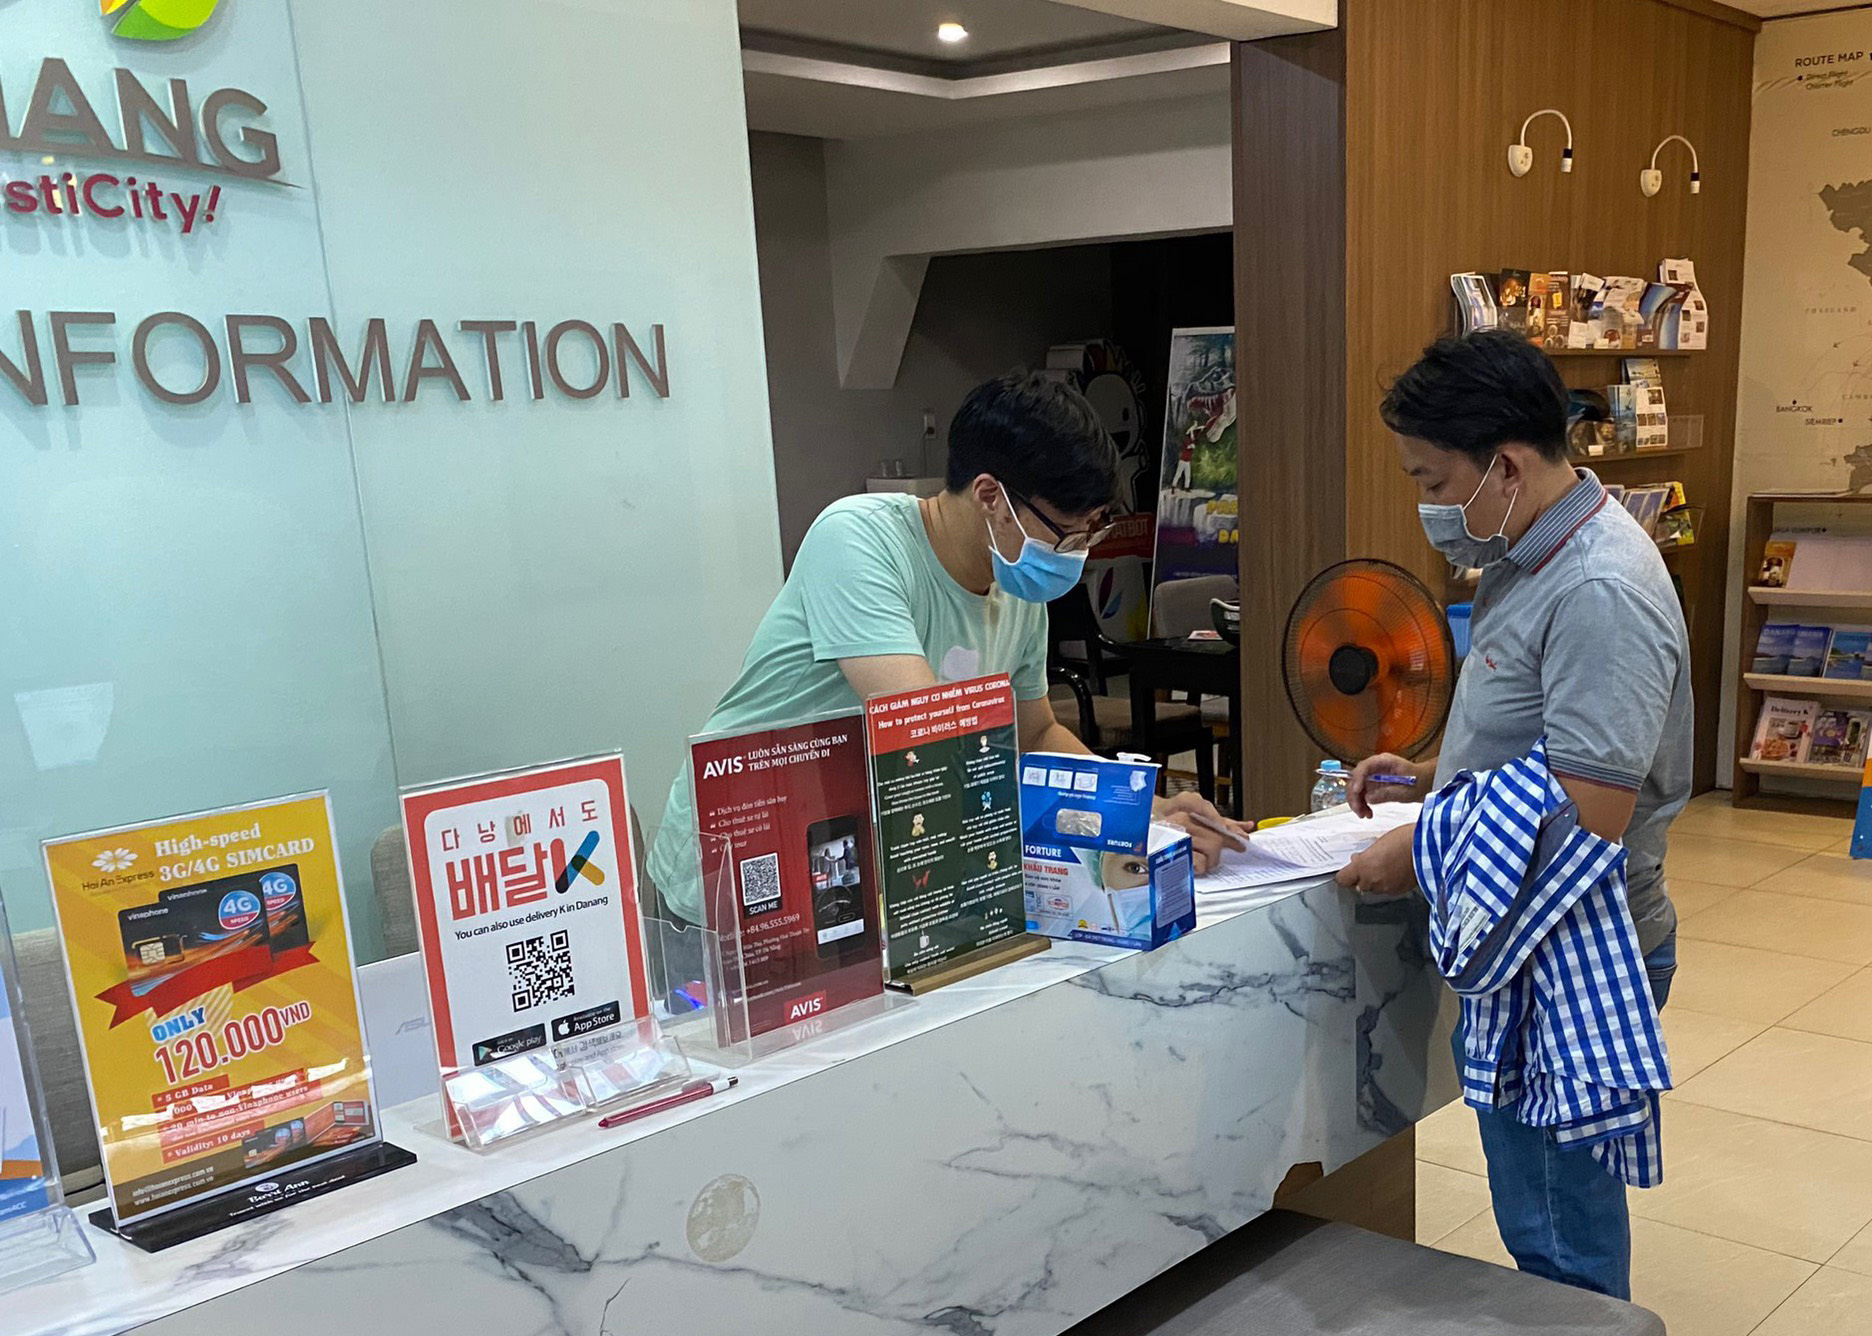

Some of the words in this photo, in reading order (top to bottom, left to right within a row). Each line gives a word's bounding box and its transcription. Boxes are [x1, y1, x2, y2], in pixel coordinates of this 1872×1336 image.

[1795, 54, 1834, 68] ROUTE
[1838, 51, 1863, 62] MAP
[1832, 127, 1871, 137] CHENGDU
[1776, 405, 1813, 413] BANGKOK
[964, 683, 984, 696] VIRUS
[985, 680, 1011, 692] CORONA
[878, 721, 893, 730] How
[895, 718, 903, 726] to
[904, 713, 927, 726] protect
[929, 706, 954, 720] yourself
[956, 703, 970, 713] from
[972, 696, 1005, 710] Coronavirus
[1771, 706, 1802, 716] Delivery
[931, 720, 957, 734] 바이러스
[748, 748, 770, 761] LUÔN
[788, 740, 809, 753] SÀNG
[809, 737, 831, 750] CÙNG
[832, 734, 848, 747] BẠN
[703, 755, 743, 780] AVIS
[748, 758, 770, 772] TRÊN
[772, 756, 788, 768] MỌI
[821, 748, 830, 758] ĐI
[154, 822, 262, 858] High-speed
[1025, 844, 1062, 857] FORTURE
[159, 856, 220, 882] 3G/4G
[226, 837, 315, 868] SIMCARD
[82, 880, 100, 891] Hoi
[100, 878, 115, 888] An
[117, 870, 155, 887] Express
[1044, 866, 1069, 876] TRANG
[127, 907, 169, 921] vinaphone
[223, 897, 252, 914] 4G
[749, 903, 768, 915] SCAN
[768, 900, 778, 909] ME
[230, 916, 249, 925] SPEED
[455, 928, 473, 941] You
[473, 923, 489, 935] can
[490, 920, 508, 932] also
[509, 916, 525, 928] use
[525, 907, 559, 923] delivery
[559, 904, 566, 914] K
[567, 903, 576, 912] in
[576, 896, 609, 910] Danang
[746, 913, 800, 934] +84.96.555.5969
[790, 998, 821, 1020] AVIS
[152, 1007, 206, 1042] ONLY
[573, 1020, 592, 1033] App
[593, 1012, 615, 1027] Store
[155, 1007, 285, 1085] 120.000
[280, 1002, 311, 1027] VND
[497, 1041, 525, 1055] Google
[526, 1034, 542, 1046] play
[165, 1094, 172, 1102] 5
[174, 1088, 189, 1099] GB
[191, 1083, 214, 1095] Data
[285, 1086, 308, 1099] users
[175, 1138, 214, 1158] Validity:
[217, 1134, 229, 1144] 10
[231, 1128, 251, 1142] days
